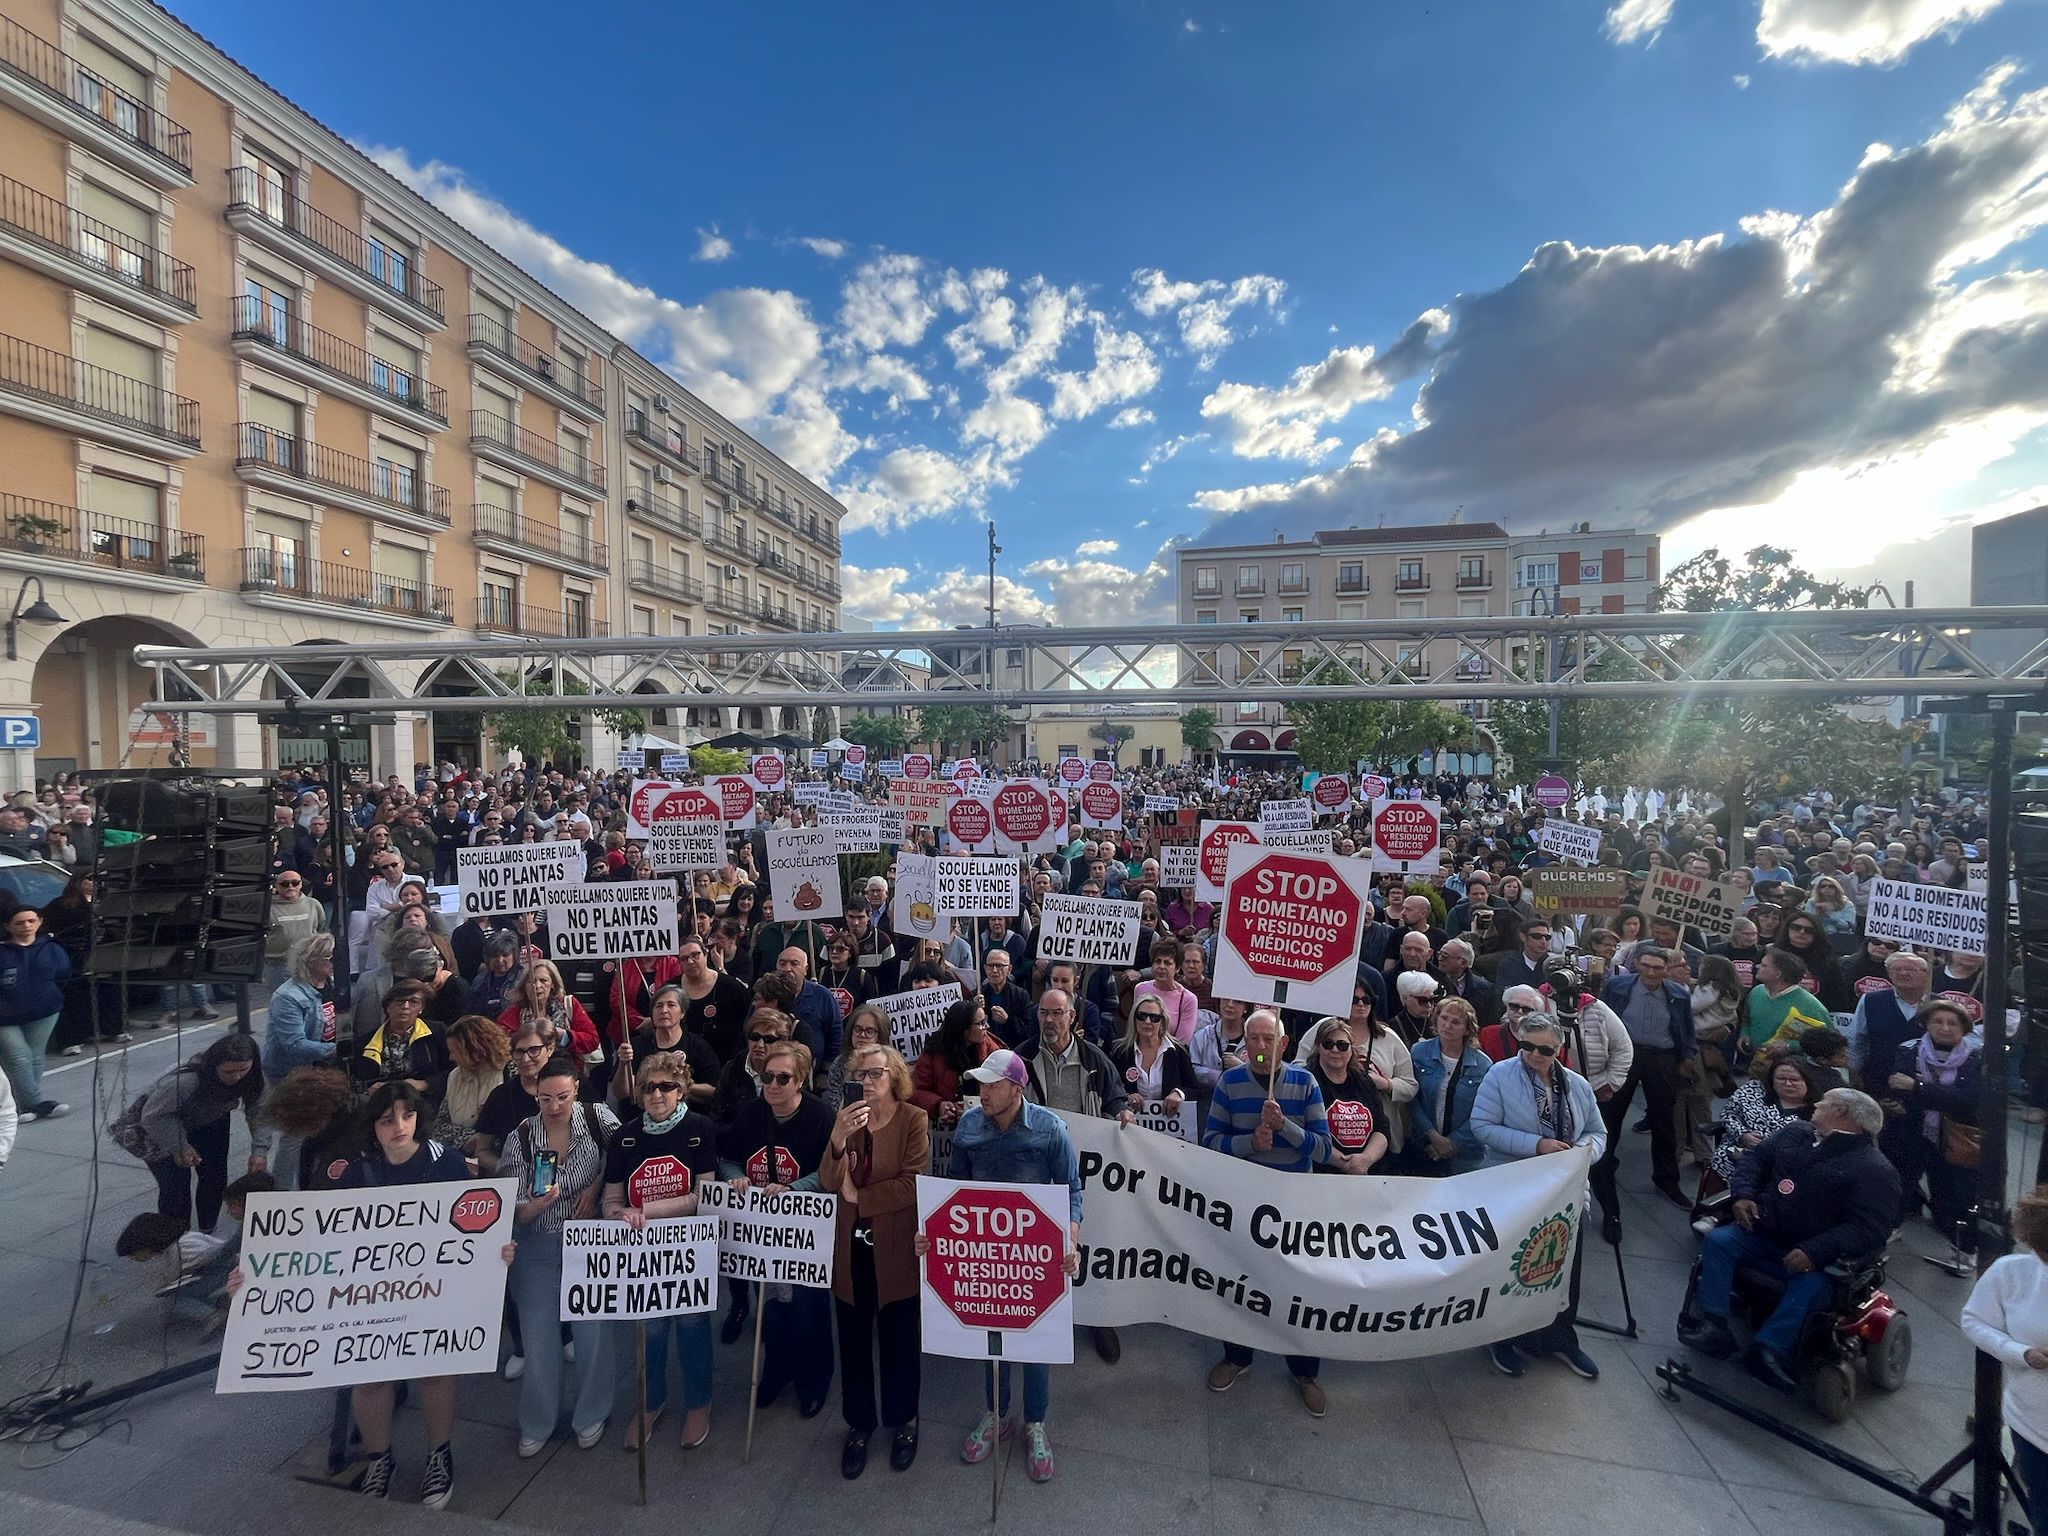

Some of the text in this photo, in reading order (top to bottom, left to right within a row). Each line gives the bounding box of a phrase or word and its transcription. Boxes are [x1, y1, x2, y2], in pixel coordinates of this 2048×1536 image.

[5, 720, 31, 744] P
[1088, 786, 1112, 796] STOP
[1320, 780, 1341, 788] STOP
[664, 798, 708, 814] STOP
[1002, 791, 1036, 805] STOP
[956, 805, 982, 815] STOP
[998, 804, 1044, 815] BIOMETANO
[1008, 814, 1042, 822] RESIDUOS
[1153, 810, 1176, 826] NO
[1386, 810, 1426, 823] STOP
[651, 823, 719, 837] SOCUÉLLAMOS
[820, 815, 878, 825] NO ES PROGRESO
[1380, 824, 1432, 833] BIOMETANO
[777, 833, 824, 848] FUTURO
[834, 829, 872, 838] ENVENENA
[1214, 832, 1250, 846] STOP
[1550, 830, 1591, 848] NO PLANTAS
[652, 838, 716, 851] NO SE VENDE,
[854, 842, 878, 852] TIERRA
[1543, 840, 1594, 860] QUE MATAN
[459, 844, 580, 867] SOCUÉLLAMOS QUIERE VIDA,
[652, 851, 718, 868] ¡SE DEFIENDE!
[478, 863, 564, 888] NO PLANTAS
[938, 860, 1018, 877] SOCUÉLLAMOS
[548, 884, 675, 904] SOCUÉLLAMOS QUIERE VIDA,
[939, 879, 1013, 894] NO SE VENDE,
[1256, 869, 1338, 902] STOP
[1707, 888, 1722, 900] A
[466, 890, 506, 914] QUE
[937, 895, 1014, 912] ¡SE DEFIENDE!
[1536, 895, 1559, 909] NO
[1652, 887, 1735, 920] RESIDUOS
[1875, 883, 1987, 912] NO AL BIOMETANO
[568, 905, 658, 928] NO PLANTAS
[1044, 898, 1140, 920] SOCUÉLLAMOS QUIERE VIDA,
[1240, 896, 1348, 928] BIOMETANO
[1873, 902, 1984, 934] NO A LOS RESIDUOS
[1056, 916, 1125, 938] NO PLANTAS
[1244, 918, 1338, 942] Y RESIDUOS
[556, 928, 672, 955] QUE MATAN
[1042, 936, 1132, 961] QUE MATAN
[1250, 932, 1324, 958] MÉDICOS
[1936, 932, 1960, 948] DICE
[1248, 951, 1324, 972] SOCUÉLLAMOS
[916, 992, 941, 1007] QUIERE
[890, 1007, 949, 1035] O PLANTAS
[1338, 1104, 1358, 1114] STOP
[644, 1162, 674, 1178] STOP
[635, 1173, 682, 1188] BIOMETANO
[642, 1182, 682, 1196] RESIDUOS
[702, 1184, 834, 1219] NO ES PROGRESO
[1079, 1150, 1146, 1194] Por
[1158, 1175, 1234, 1232] una
[1250, 1204, 1406, 1262] Cuenca
[1412, 1207, 1499, 1260] SIN
[250, 1199, 495, 1238] NOS VENDEN STOP
[950, 1204, 1037, 1238] STOP
[566, 1222, 718, 1247] SOCUÉLLAMOS QUIERE VIDA,
[733, 1222, 816, 1250] ENVENENA
[248, 1239, 475, 1279] VERDE, PERO ES
[936, 1237, 1053, 1264] BIOMETANO
[586, 1248, 696, 1279] NO PLANTAS
[720, 1252, 828, 1284] ESTRA TIERRA
[944, 1262, 1046, 1281] Y RESIDUOS
[242, 1273, 442, 1317] PURO MARRÓN
[567, 1277, 710, 1316] QUE MATAN
[954, 1278, 1034, 1300] MÉDICOS
[1072, 1242, 1490, 1333] ganadería industrial
[954, 1300, 1036, 1318] SOCUÉLLAMOS
[243, 1326, 486, 1371] STOP BIOMETANO
